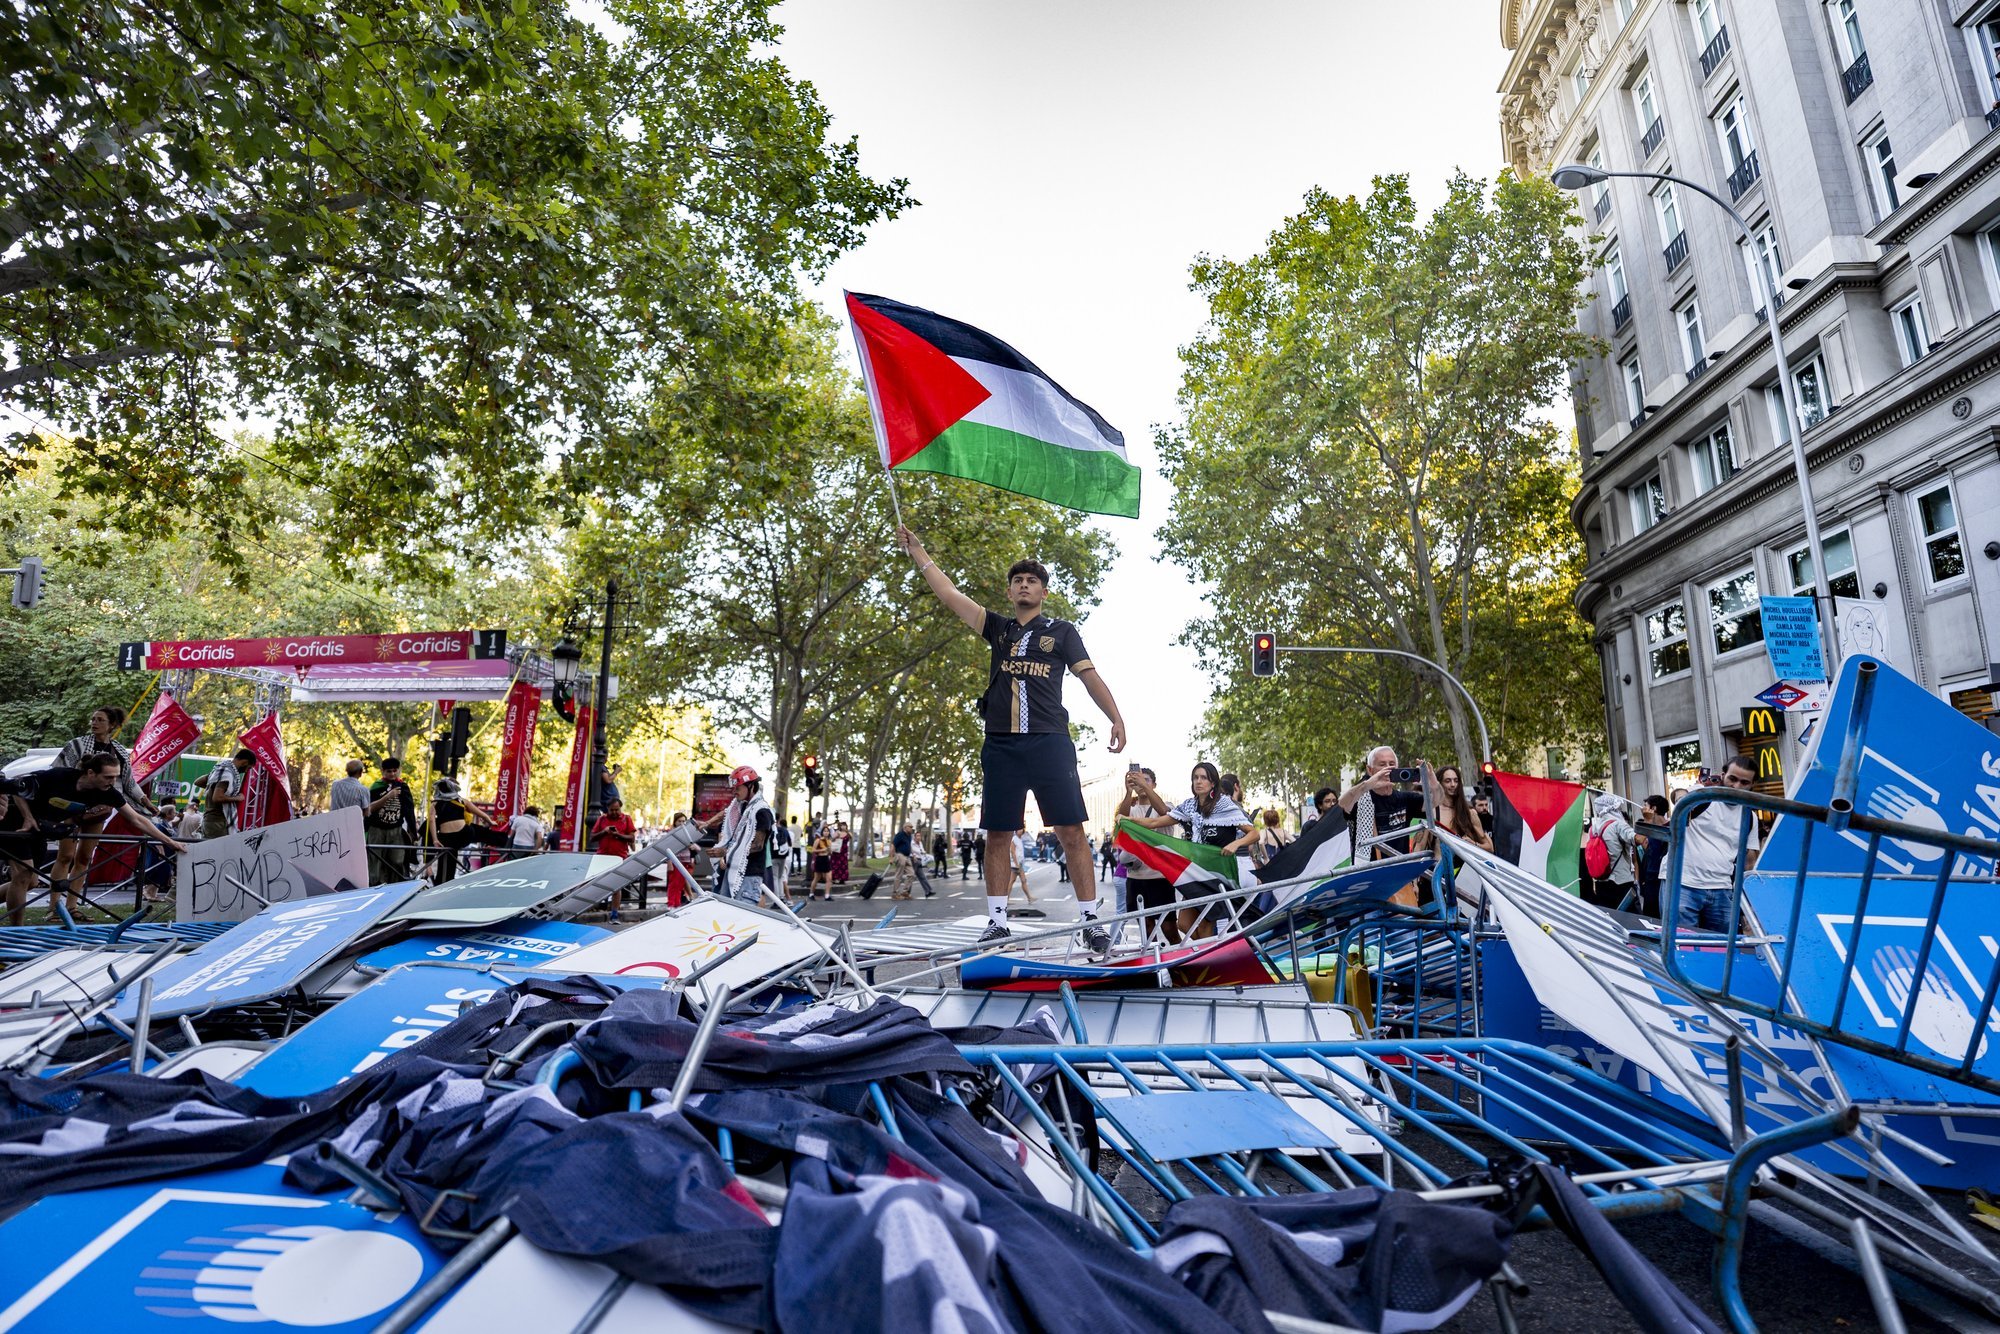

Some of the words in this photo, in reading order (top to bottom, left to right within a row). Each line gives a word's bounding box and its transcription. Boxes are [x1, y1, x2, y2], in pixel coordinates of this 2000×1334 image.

[125, 645, 133, 661] 1
[178, 644, 235, 661] Cofidis
[285, 640, 344, 658] Cofidis
[398, 637, 461, 654] Cofidis
[489, 632, 496, 649] 1
[135, 722, 169, 751] Cofidis
[505, 704, 517, 745] Cofidis
[524, 709, 535, 749] Cofidis
[148, 737, 183, 764] Cofidis
[574, 726, 584, 762] Cofidis
[257, 746, 281, 775] Cofidis
[497, 769, 510, 810] Cofidis
[565, 783, 575, 818] Cofidis
[288, 828, 351, 859] ISREAL
[191, 850, 292, 919] BOMB
[476, 934, 567, 954] DEPORTE
